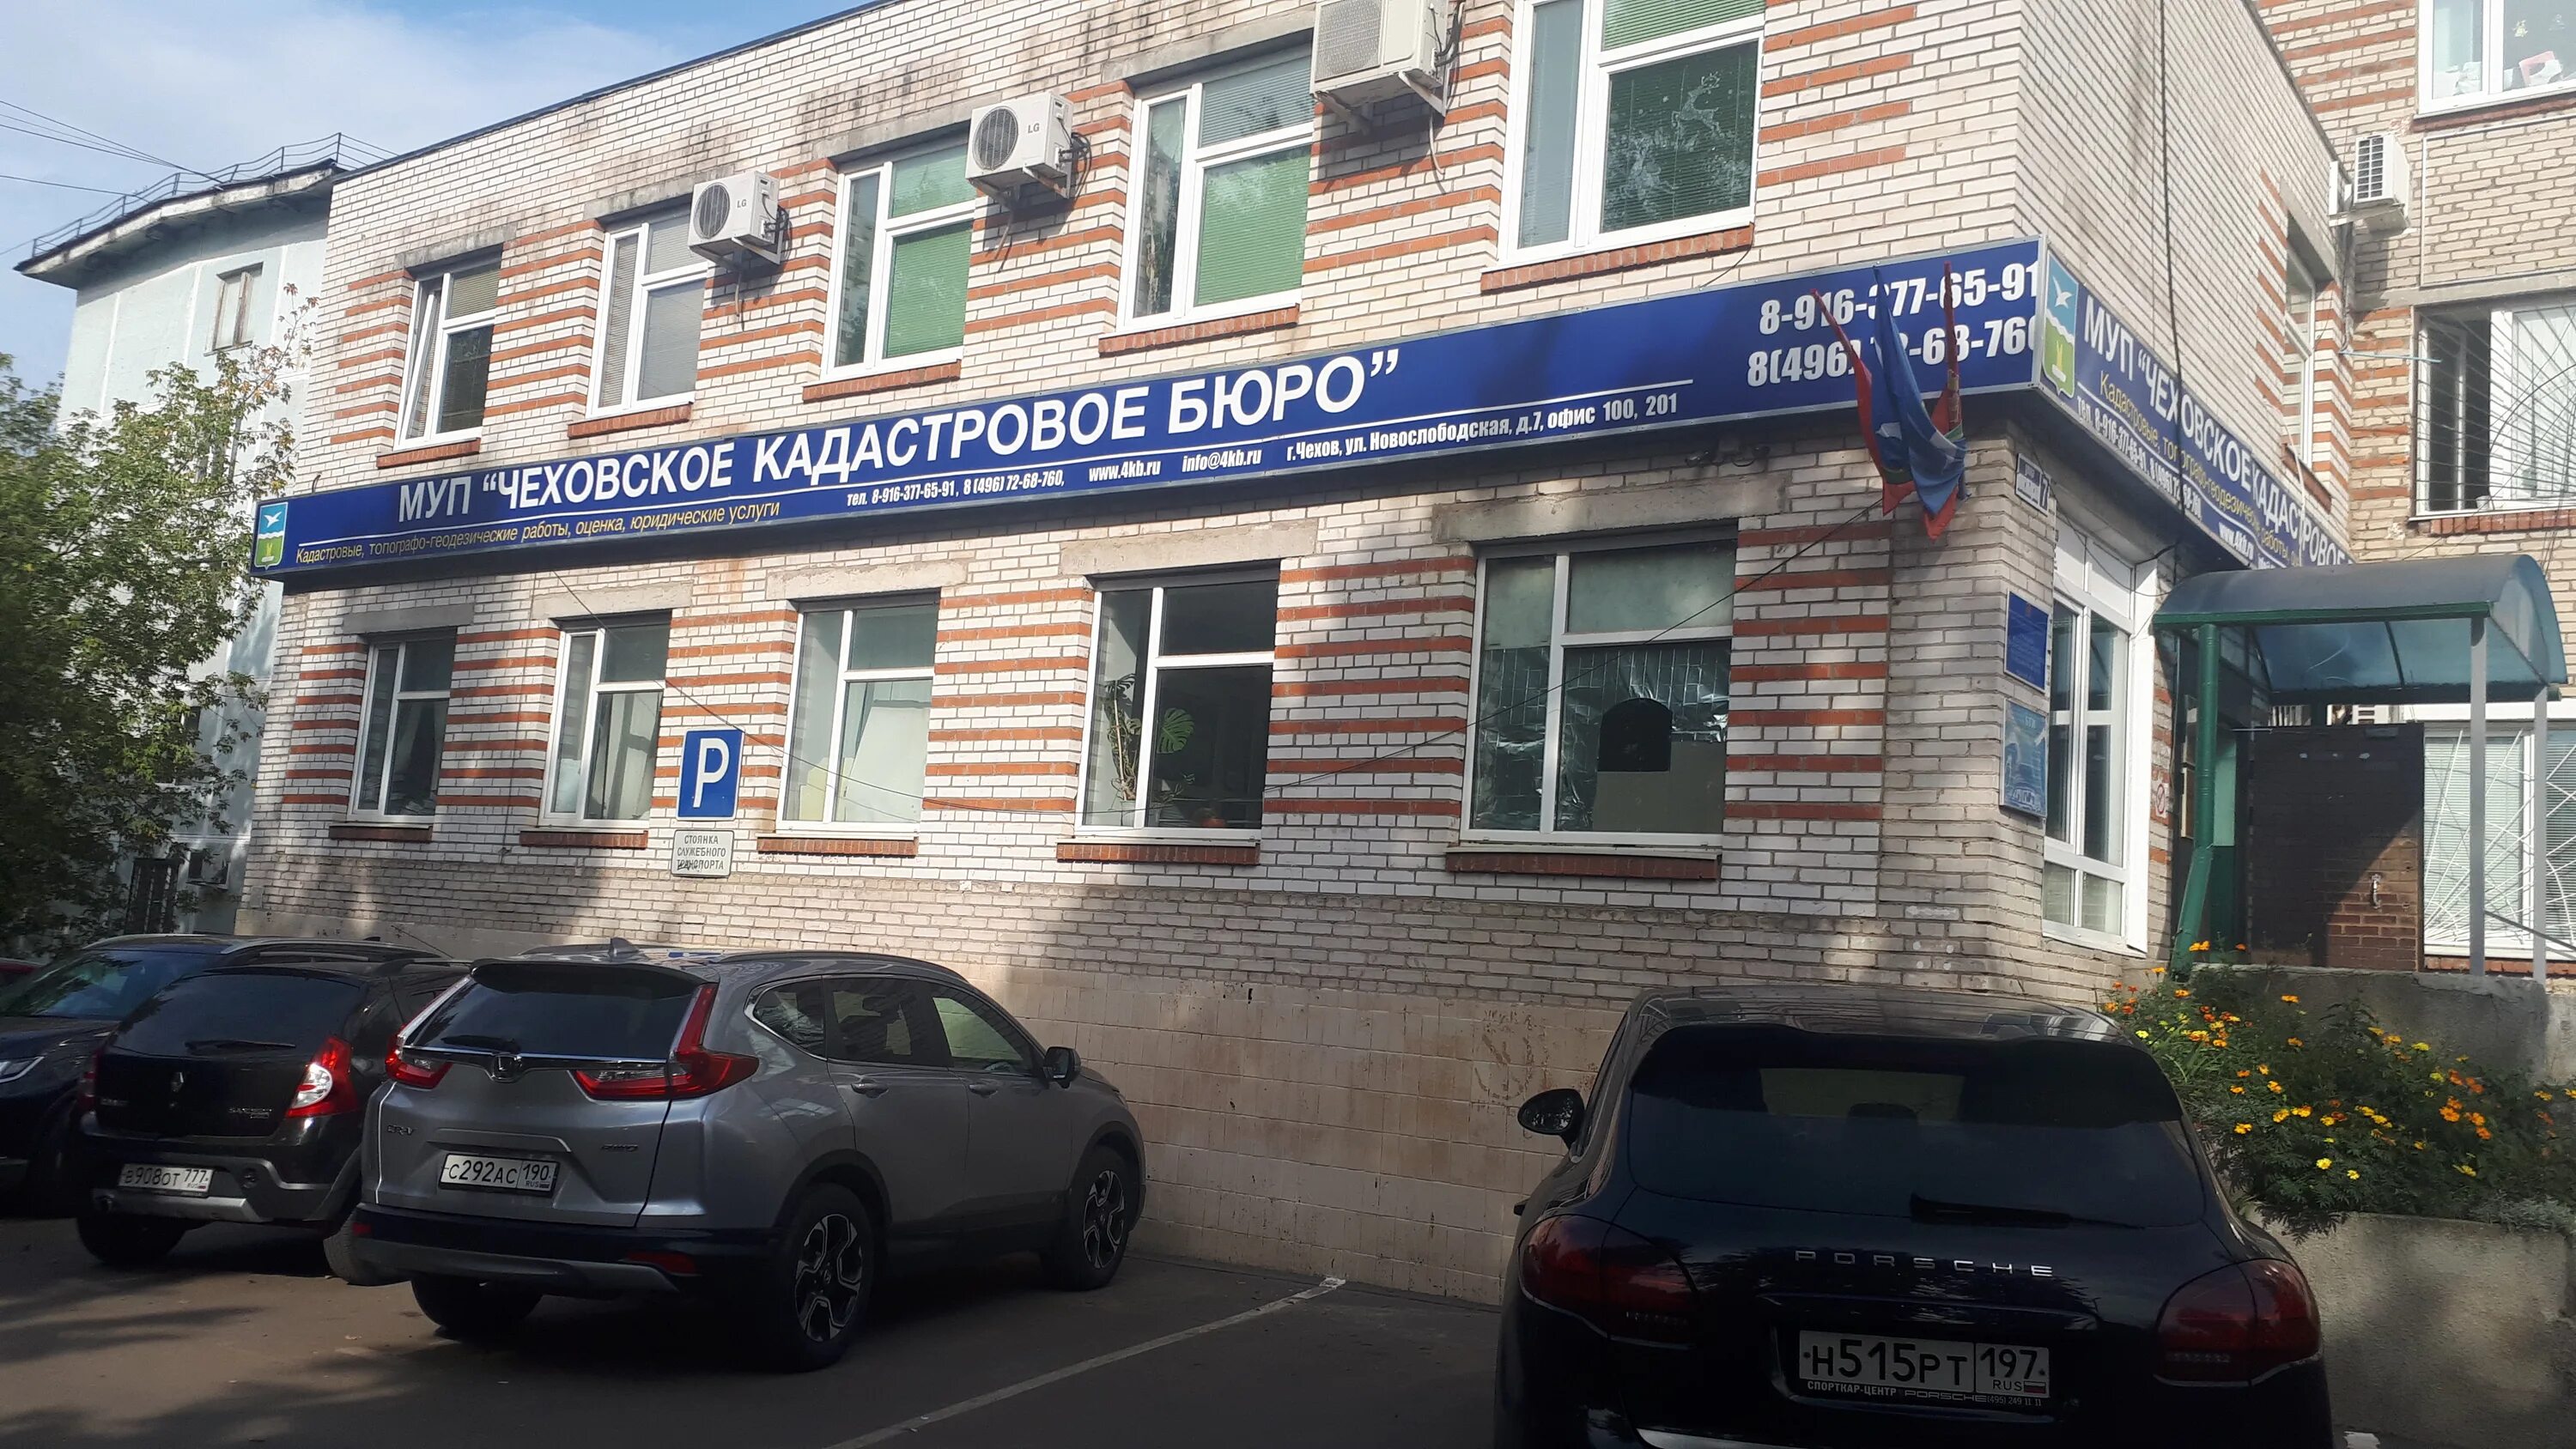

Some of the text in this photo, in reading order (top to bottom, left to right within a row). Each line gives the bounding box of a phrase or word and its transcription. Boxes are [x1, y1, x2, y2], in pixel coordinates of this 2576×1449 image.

[1028, 122, 1040, 135] LG
[737, 198, 747, 209] LG
[2084, 294, 2133, 381] МУП
[2137, 349, 2251, 493] “ЧЕХОВСКОЕ
[2100, 370, 2160, 453] Кадастровые,
[398, 349, 1399, 522] МУП “ЧЕХОВСКОЕ КАДАСТРОВОЕ БЮРО”
[1286, 392, 1678, 462] г.Чехов, ул. Новослободская, д.7, офис 100, 201
[1089, 460, 1162, 482] www.4kb.ru
[1182, 449, 1262, 472] info@4kb.ru
[2077, 396, 2093, 424] тел.
[2172, 476, 2202, 520] 7268-760,
[847, 470, 1065, 506] тел. 8-916-377-65-91, 8 (496) 72-68-760,
[2042, 477, 2049, 506] 7
[295, 501, 781, 564] Кадастровые, топографо-геодезические работы, оценка, юридические услуги
[693, 737, 730, 808] P
[677, 846, 726, 858] СЛУЖЕБНОГО
[684, 834, 719, 845] СТОЯНКА
[677, 858, 724, 870] ТРАНСПОРТА
[185, 1168, 207, 1182] 777
[448, 1160, 550, 1185] С292АС 190
[1795, 1250, 2053, 1277] PORSCHE
[1979, 1347, 2038, 1379] 197
[1807, 1380, 1897, 1397] СПОРТКАР-ЦЕНТР
[1904, 1390, 1987, 1404] PORSCHE
[1987, 1395, 2007, 1405] (495)
[1992, 1379, 2022, 1391] RUS
